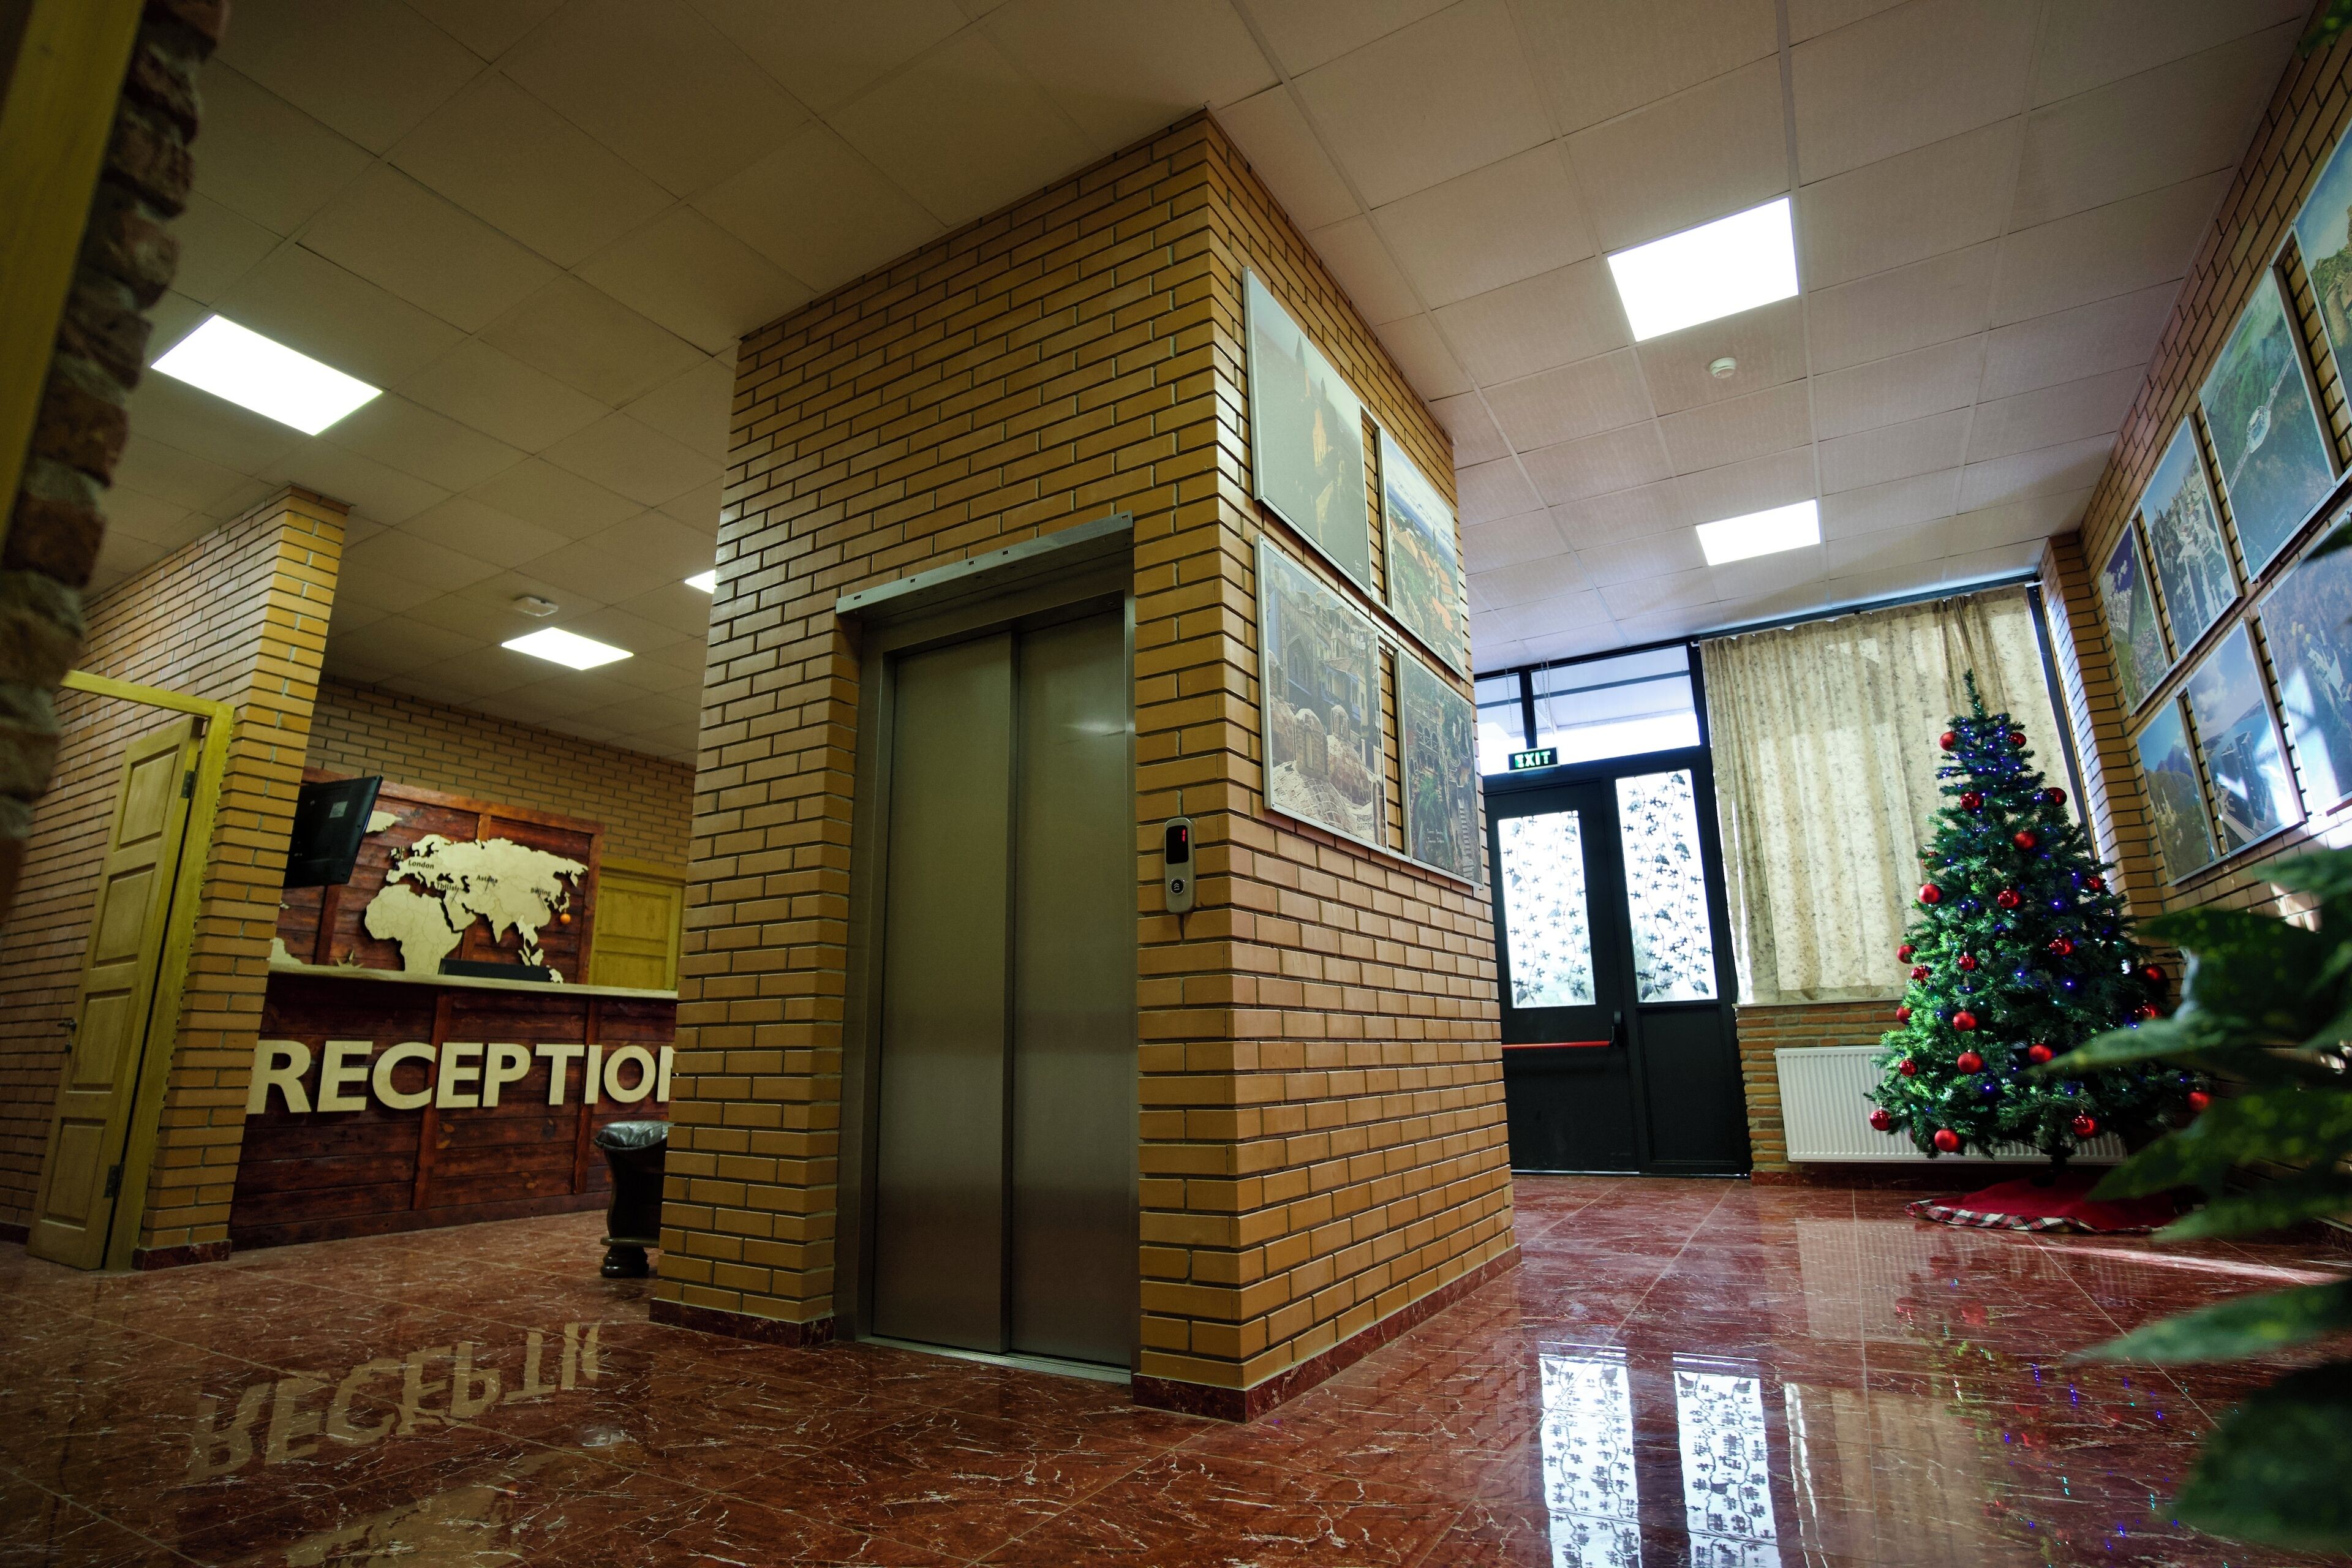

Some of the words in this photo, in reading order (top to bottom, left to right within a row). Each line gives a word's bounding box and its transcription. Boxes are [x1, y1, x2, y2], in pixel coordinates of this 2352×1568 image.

[1514, 751, 1551, 768] EXIT
[1182, 829, 1186, 842] 1
[408, 859, 434, 869] London
[246, 1039, 674, 1114] RECEPTIO
